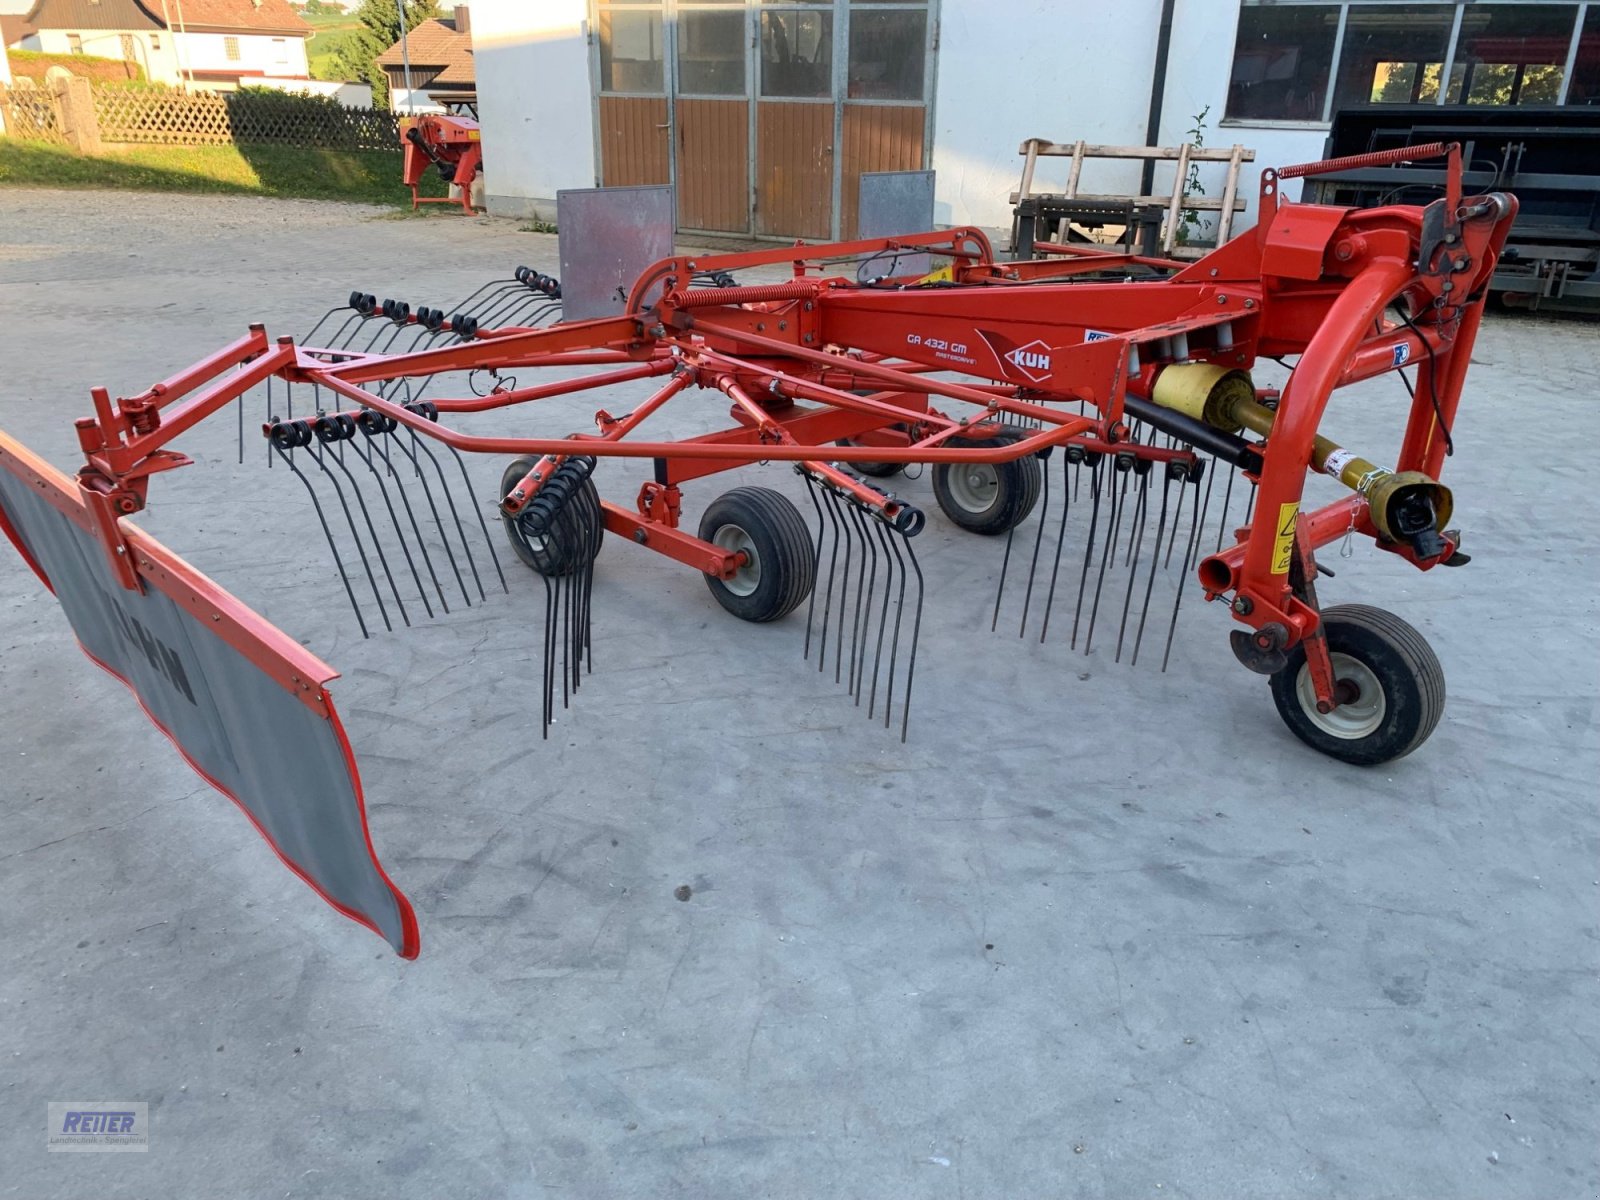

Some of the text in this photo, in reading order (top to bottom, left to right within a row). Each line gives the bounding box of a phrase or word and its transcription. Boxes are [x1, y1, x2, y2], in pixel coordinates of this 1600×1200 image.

[907, 334, 967, 355] GA 4321 GM
